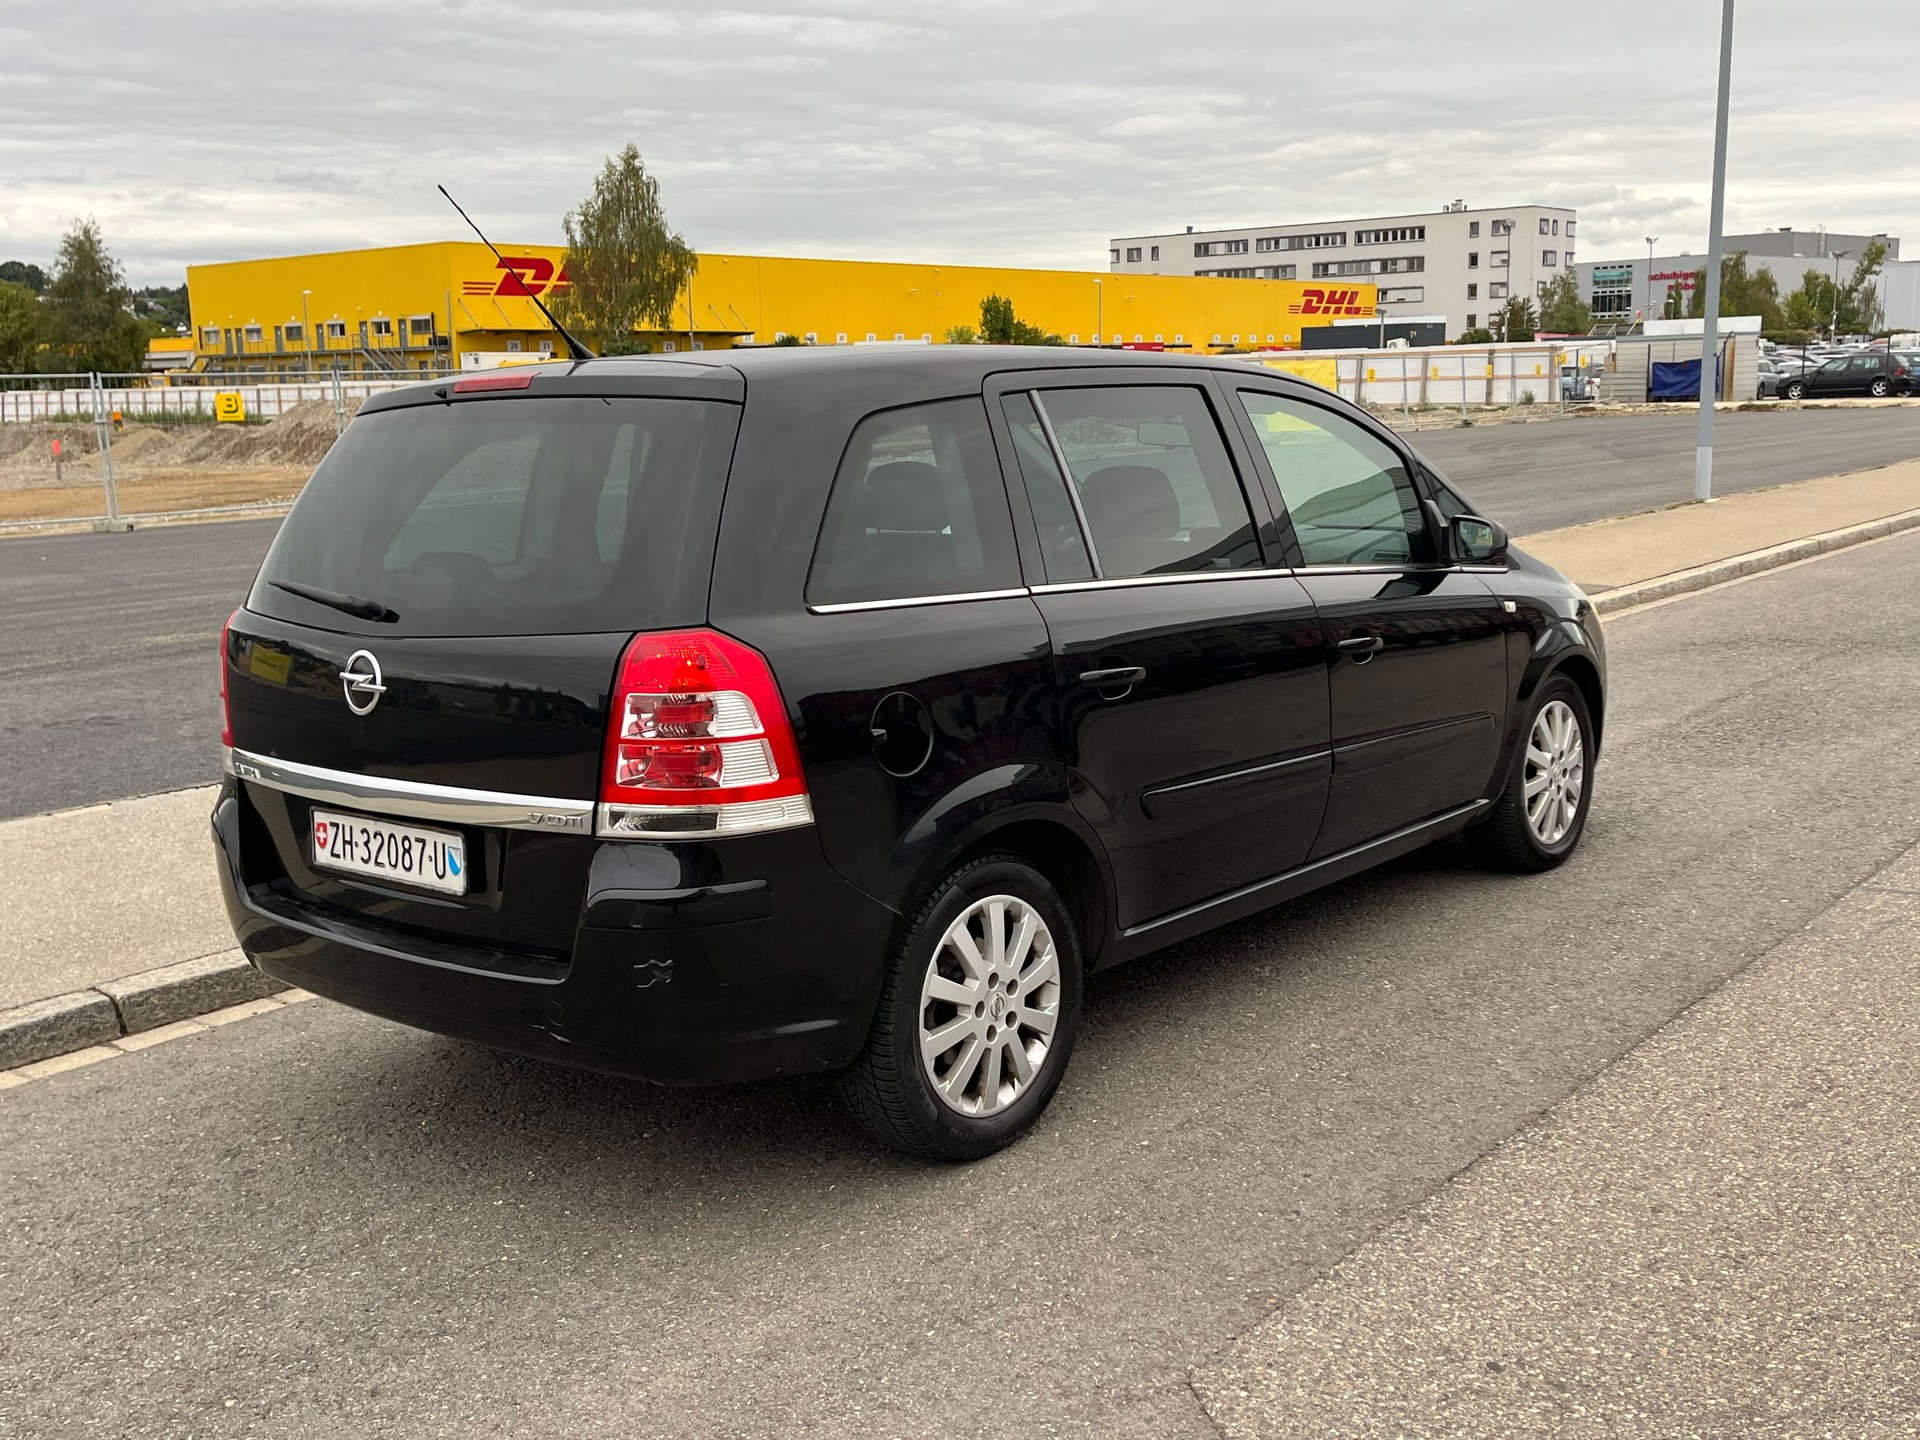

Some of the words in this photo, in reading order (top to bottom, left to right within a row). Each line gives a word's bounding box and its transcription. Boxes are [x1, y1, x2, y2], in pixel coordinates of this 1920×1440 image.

[1648, 270, 1698, 281] schubige
[1301, 289, 1362, 315] DHL
[510, 342, 519, 350] 20
[543, 342, 550, 350] 21
[666, 342, 673, 350] 25
[545, 814, 583, 828] CDTI
